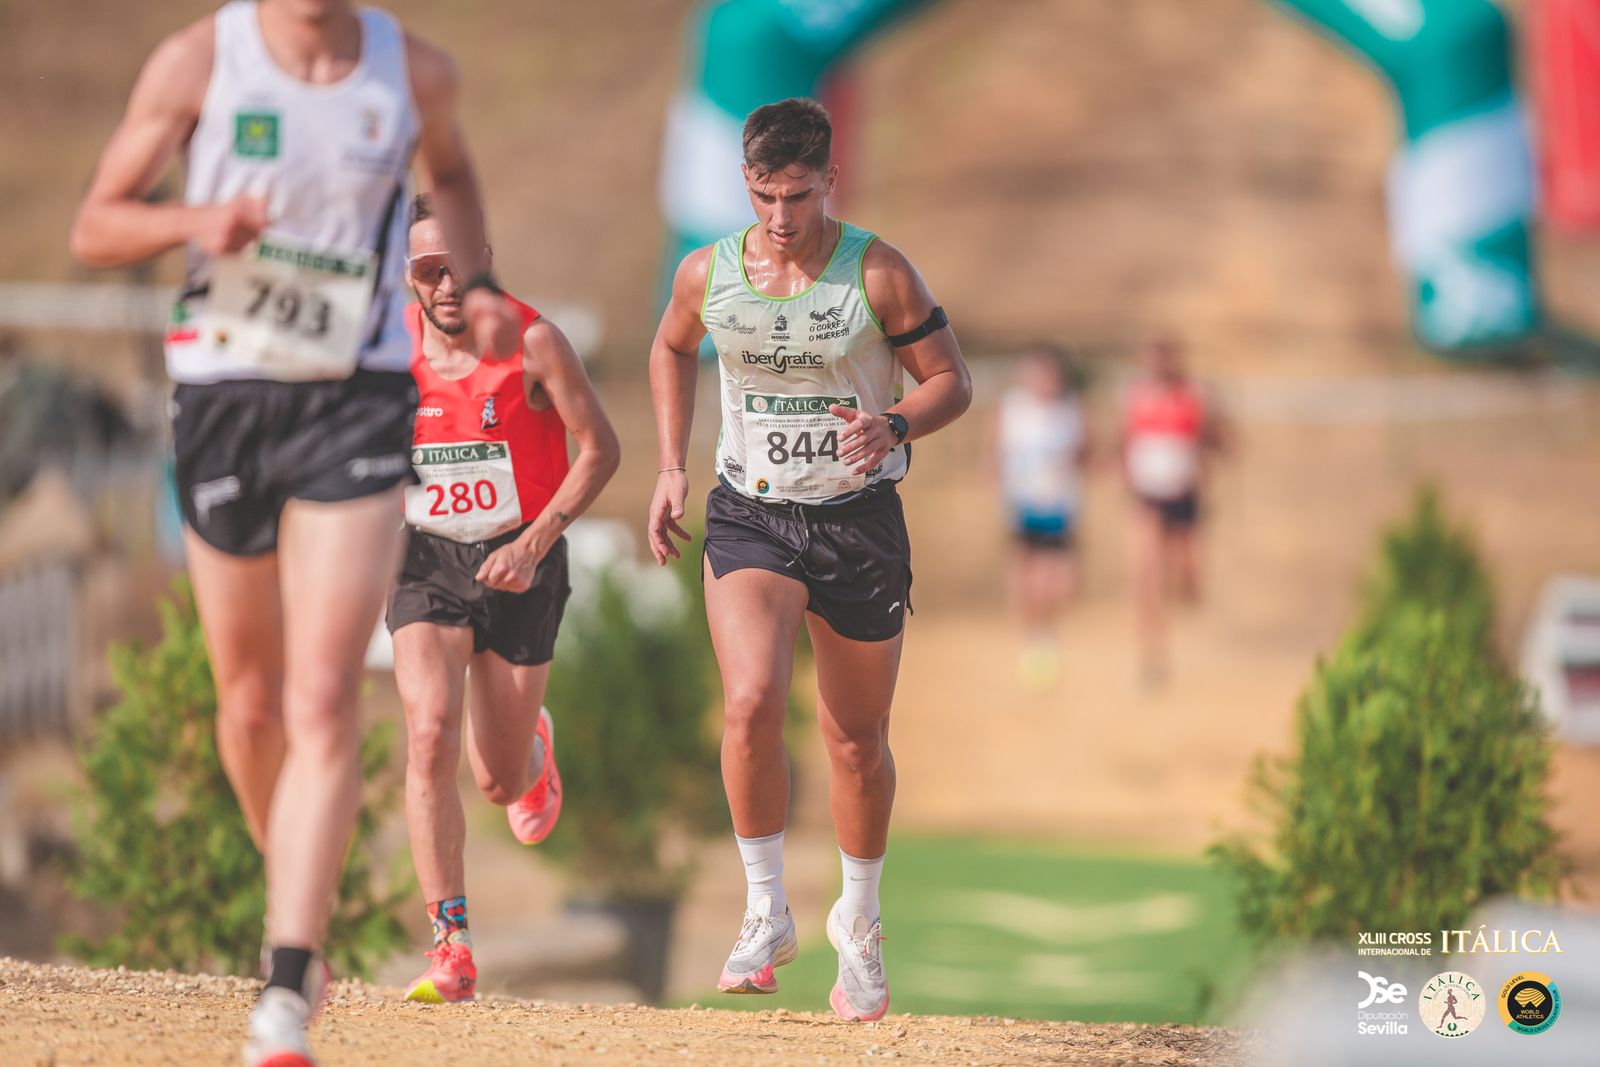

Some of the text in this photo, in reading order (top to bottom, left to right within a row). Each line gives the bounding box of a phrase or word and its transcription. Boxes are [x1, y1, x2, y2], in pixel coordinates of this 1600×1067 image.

[247, 278, 329, 339] 793
[816, 320, 846, 331] CORRES
[816, 326, 850, 340] MUERES!!
[774, 399, 828, 412] ITÁLICA
[428, 447, 478, 462] ITÁLICA
[766, 430, 839, 464] 844
[426, 480, 497, 516] 280
